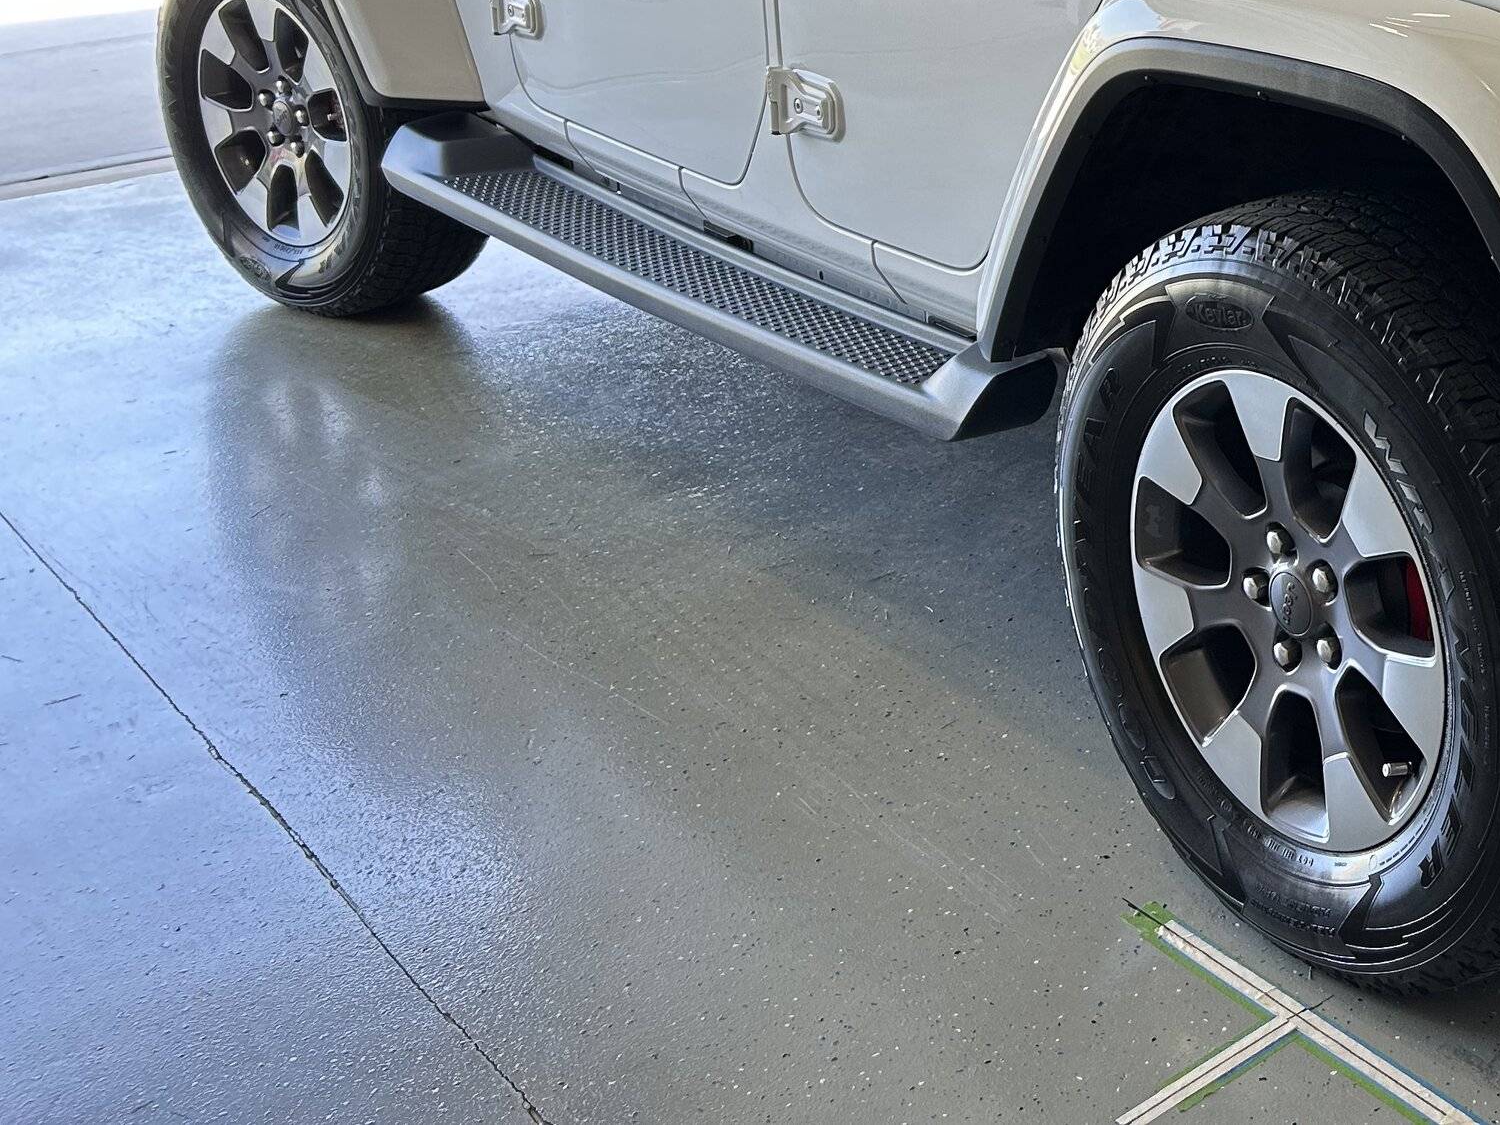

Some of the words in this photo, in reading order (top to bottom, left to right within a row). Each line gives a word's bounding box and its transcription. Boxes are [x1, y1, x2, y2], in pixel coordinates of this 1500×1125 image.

[1072, 367, 1176, 799] GOODYEAR
[1282, 581, 1298, 625] Jeep
[1362, 412, 1479, 890] WRANGLER
